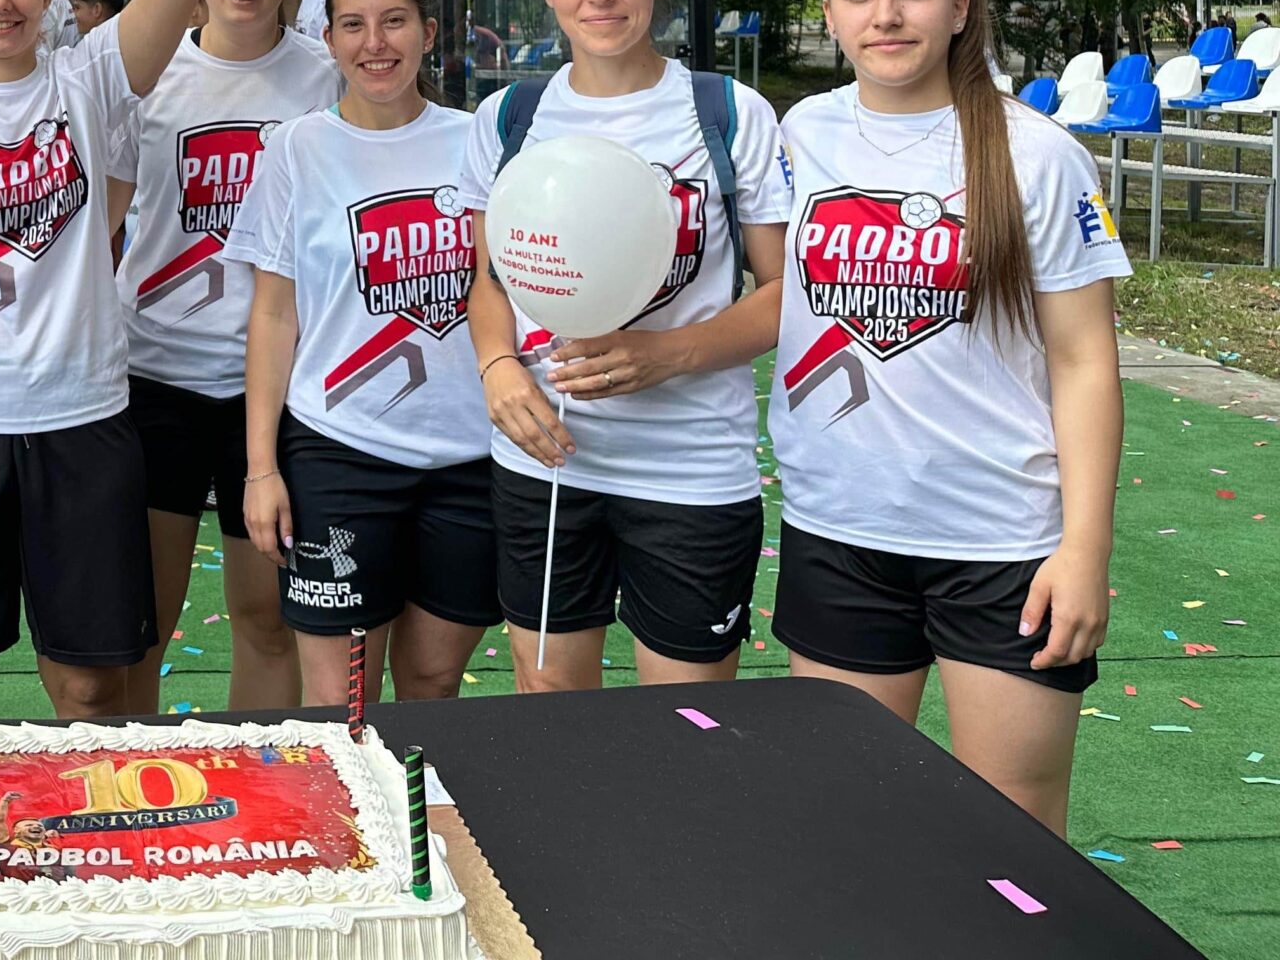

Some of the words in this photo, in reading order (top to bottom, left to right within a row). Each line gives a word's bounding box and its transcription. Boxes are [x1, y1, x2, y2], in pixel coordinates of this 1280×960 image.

[20, 221, 53, 247] 2025
[358, 214, 475, 267] PADBO
[510, 228, 524, 242] 10
[528, 232, 558, 248] ANI
[396, 250, 471, 280] NATIONAL
[498, 256, 529, 272] PADBOL
[530, 265, 584, 279] ROMÂNIA
[504, 246, 513, 255] LA
[515, 249, 543, 264] MULȚI
[545, 255, 566, 265] ANI
[836, 260, 937, 288] NATIONAL
[518, 280, 575, 296] PADBOL
[422, 301, 457, 326] 2025
[863, 318, 909, 342] 2025
[289, 575, 351, 595] UNDER
[287, 587, 363, 608] ARMOUR
[57, 803, 230, 831] ANNIVERSARY
[143, 838, 318, 867] ROMÂNIA
